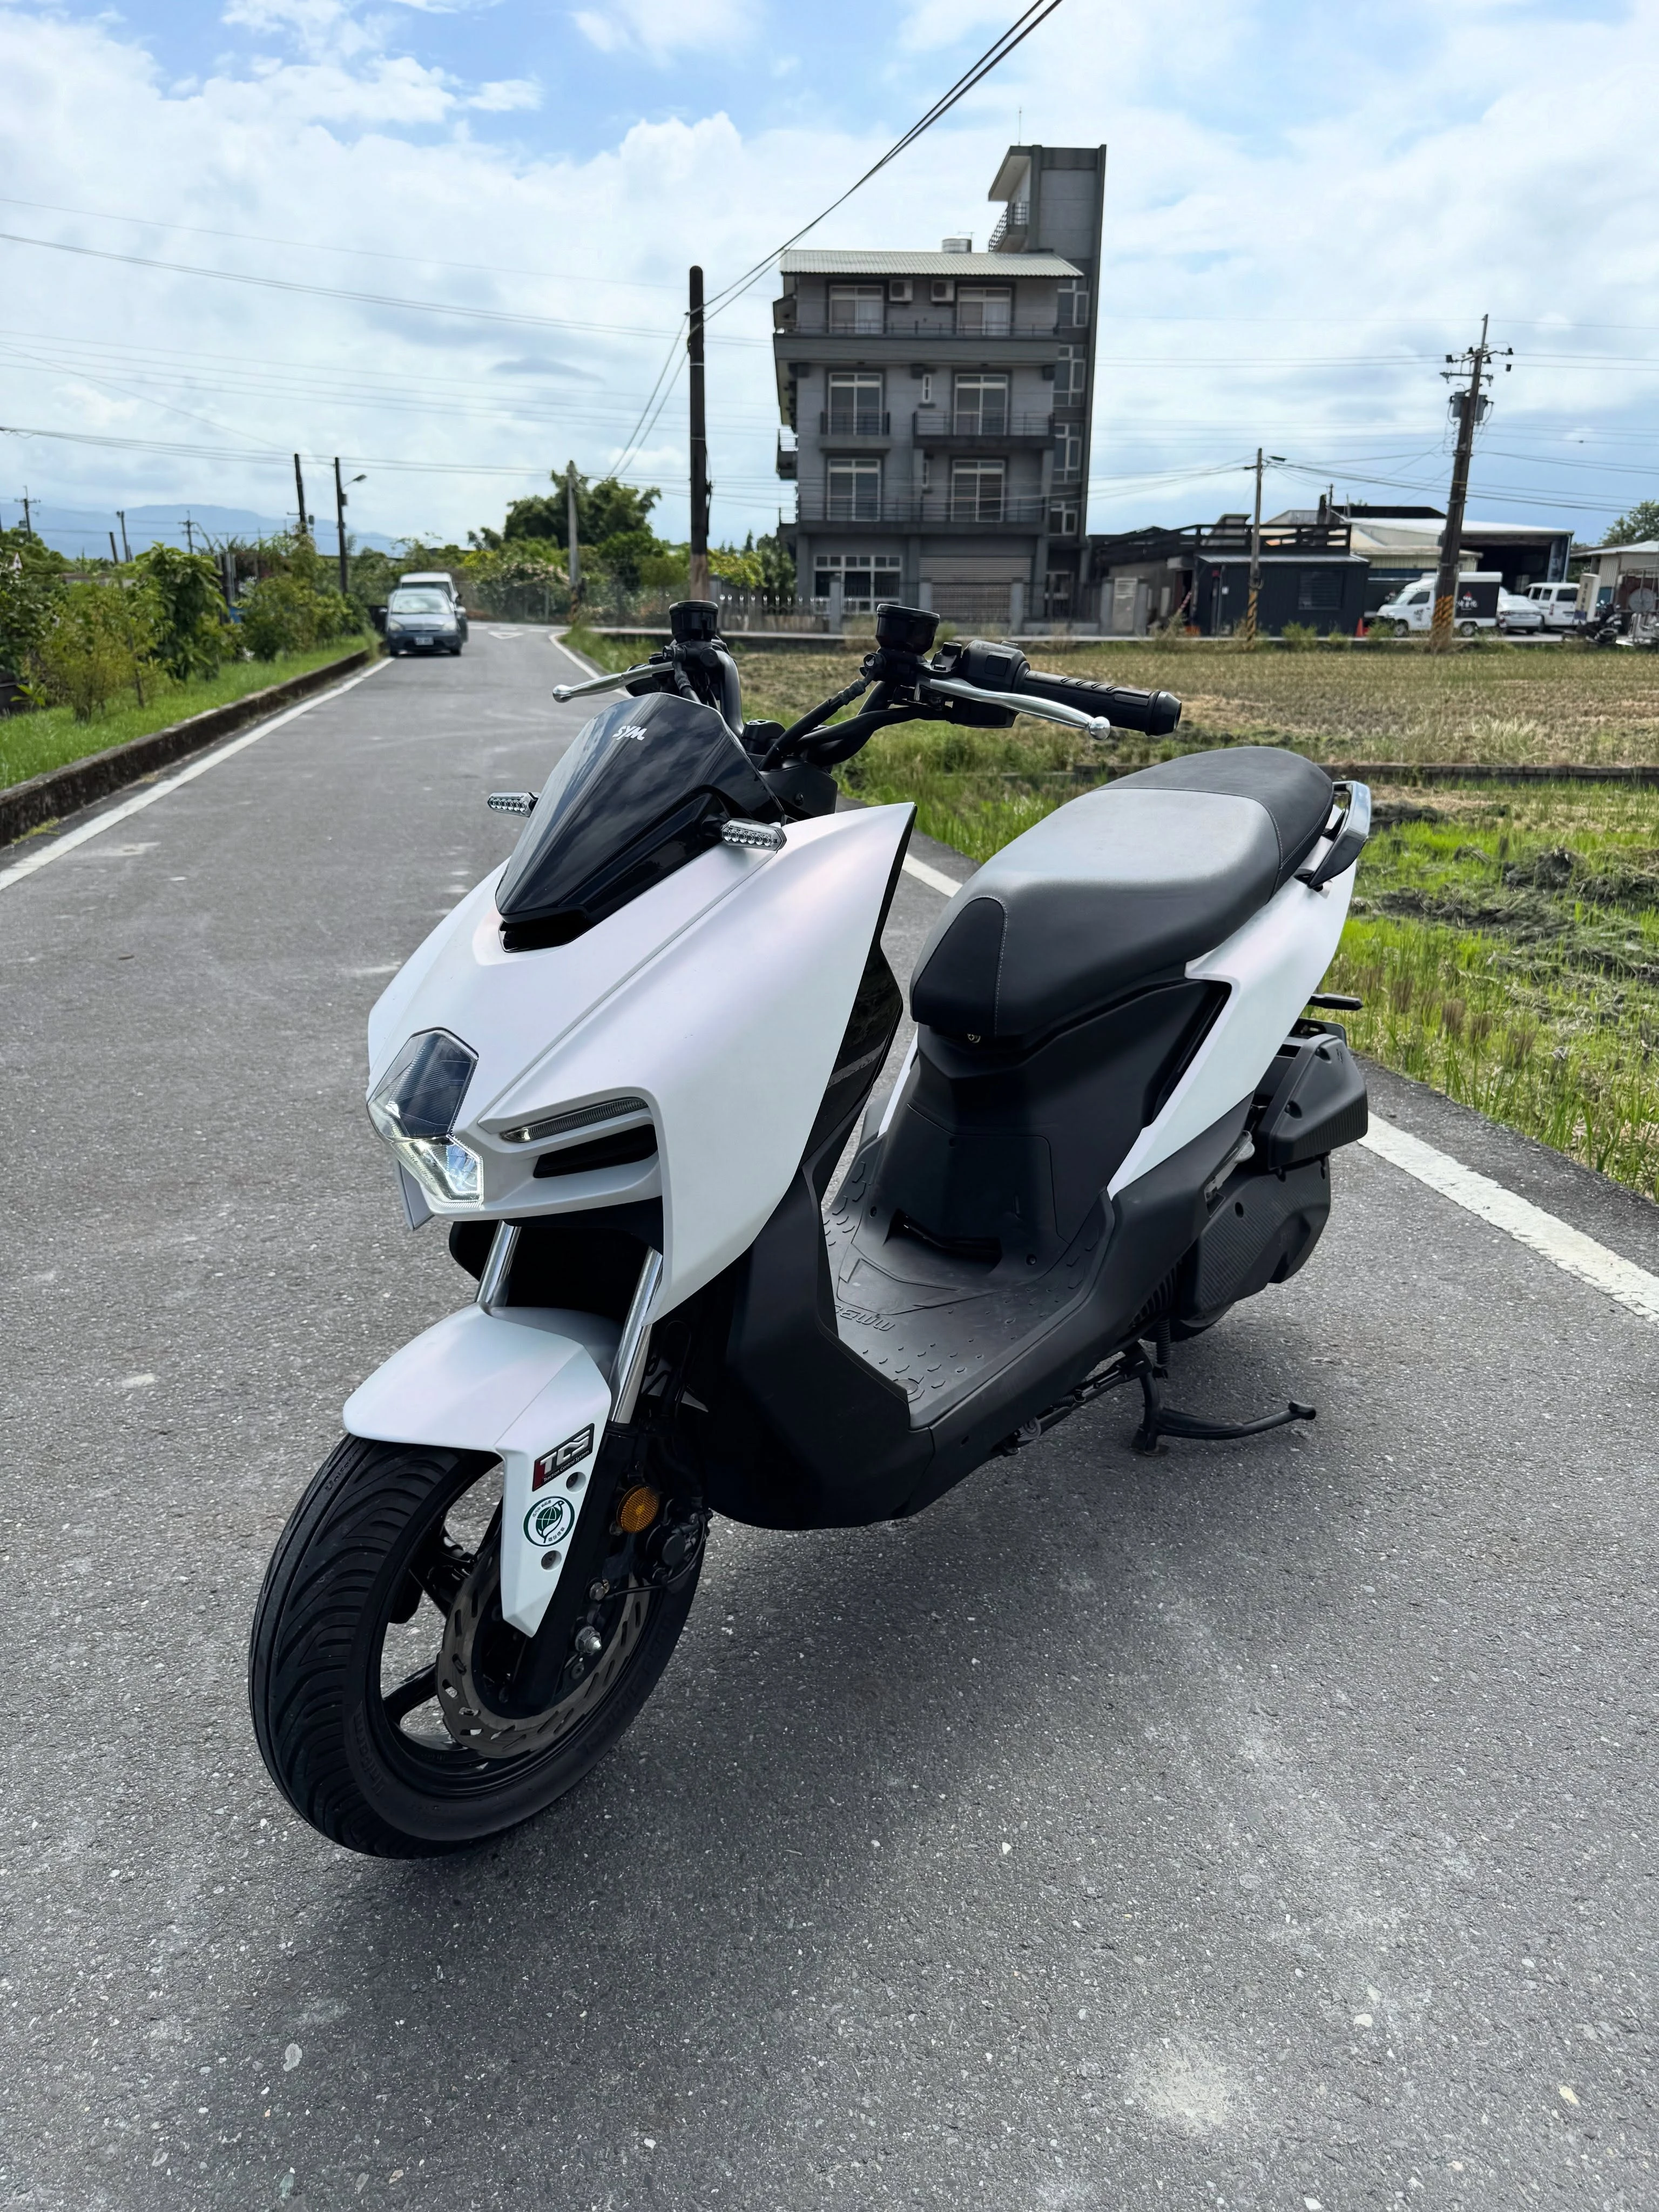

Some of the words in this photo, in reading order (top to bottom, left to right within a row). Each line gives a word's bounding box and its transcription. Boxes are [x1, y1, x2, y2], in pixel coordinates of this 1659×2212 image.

[612, 725, 648, 741] SYM
[540, 1429, 590, 1475] TCS
[543, 1470, 560, 1482] Traction
[559, 1458, 576, 1472] Control
[575, 1450, 589, 1462] System
